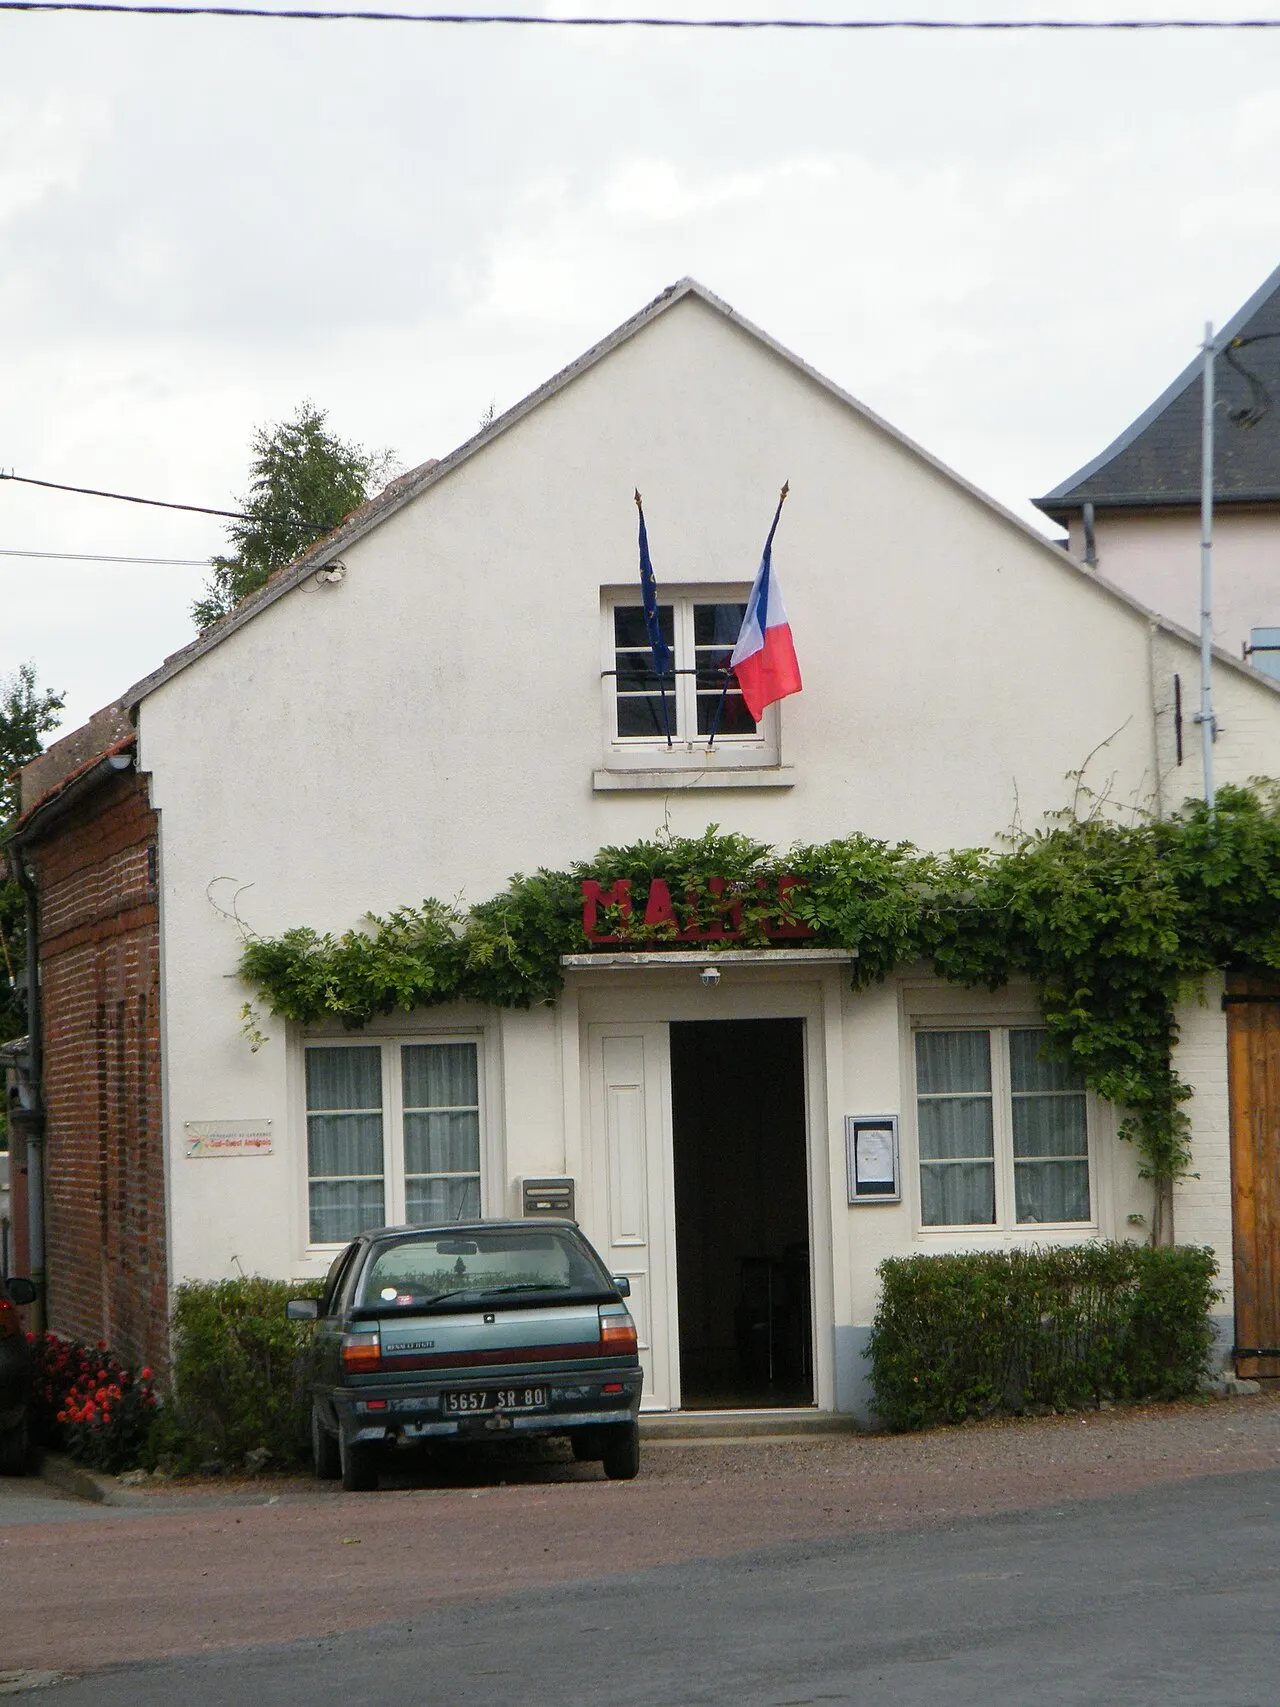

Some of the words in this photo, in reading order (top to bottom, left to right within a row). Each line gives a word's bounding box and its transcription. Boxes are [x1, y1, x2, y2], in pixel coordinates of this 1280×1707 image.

[582, 876, 816, 941] MARE
[450, 1393, 487, 1410] 5657
[497, 1391, 516, 1408] SR
[524, 1388, 543, 1405] 80
